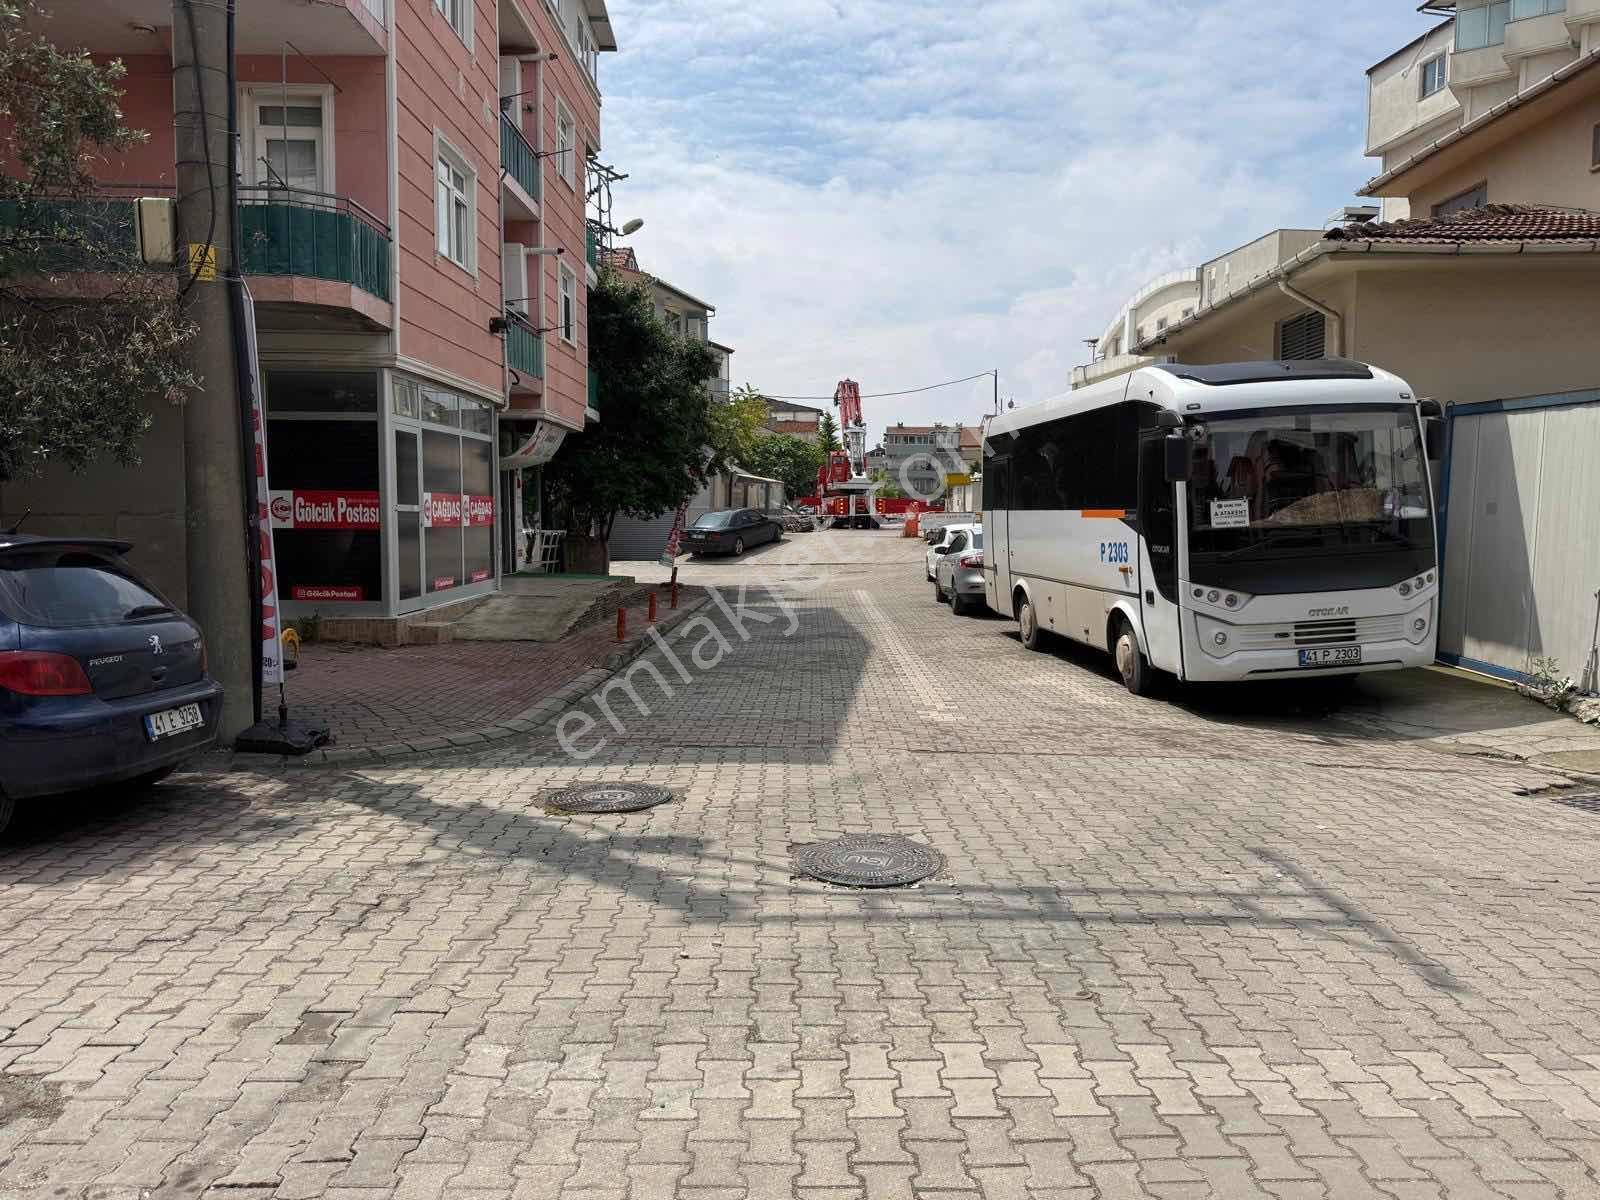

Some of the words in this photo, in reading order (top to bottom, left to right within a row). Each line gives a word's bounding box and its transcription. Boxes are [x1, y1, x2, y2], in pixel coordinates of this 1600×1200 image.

[295, 497, 336, 523] Gölcük
[337, 497, 380, 523] Postası
[432, 498, 461, 521] ÇAĞDAŞ
[1100, 542, 1106, 562] P
[1107, 542, 1128, 562] 2303
[1308, 606, 1349, 617] OTOKAR
[89, 655, 124, 667] PEUGEOT
[1306, 650, 1318, 662] 41
[1322, 649, 1331, 661] P
[1334, 647, 1359, 660] 2303
[155, 715, 166, 732] 41
[168, 711, 177, 728] E
